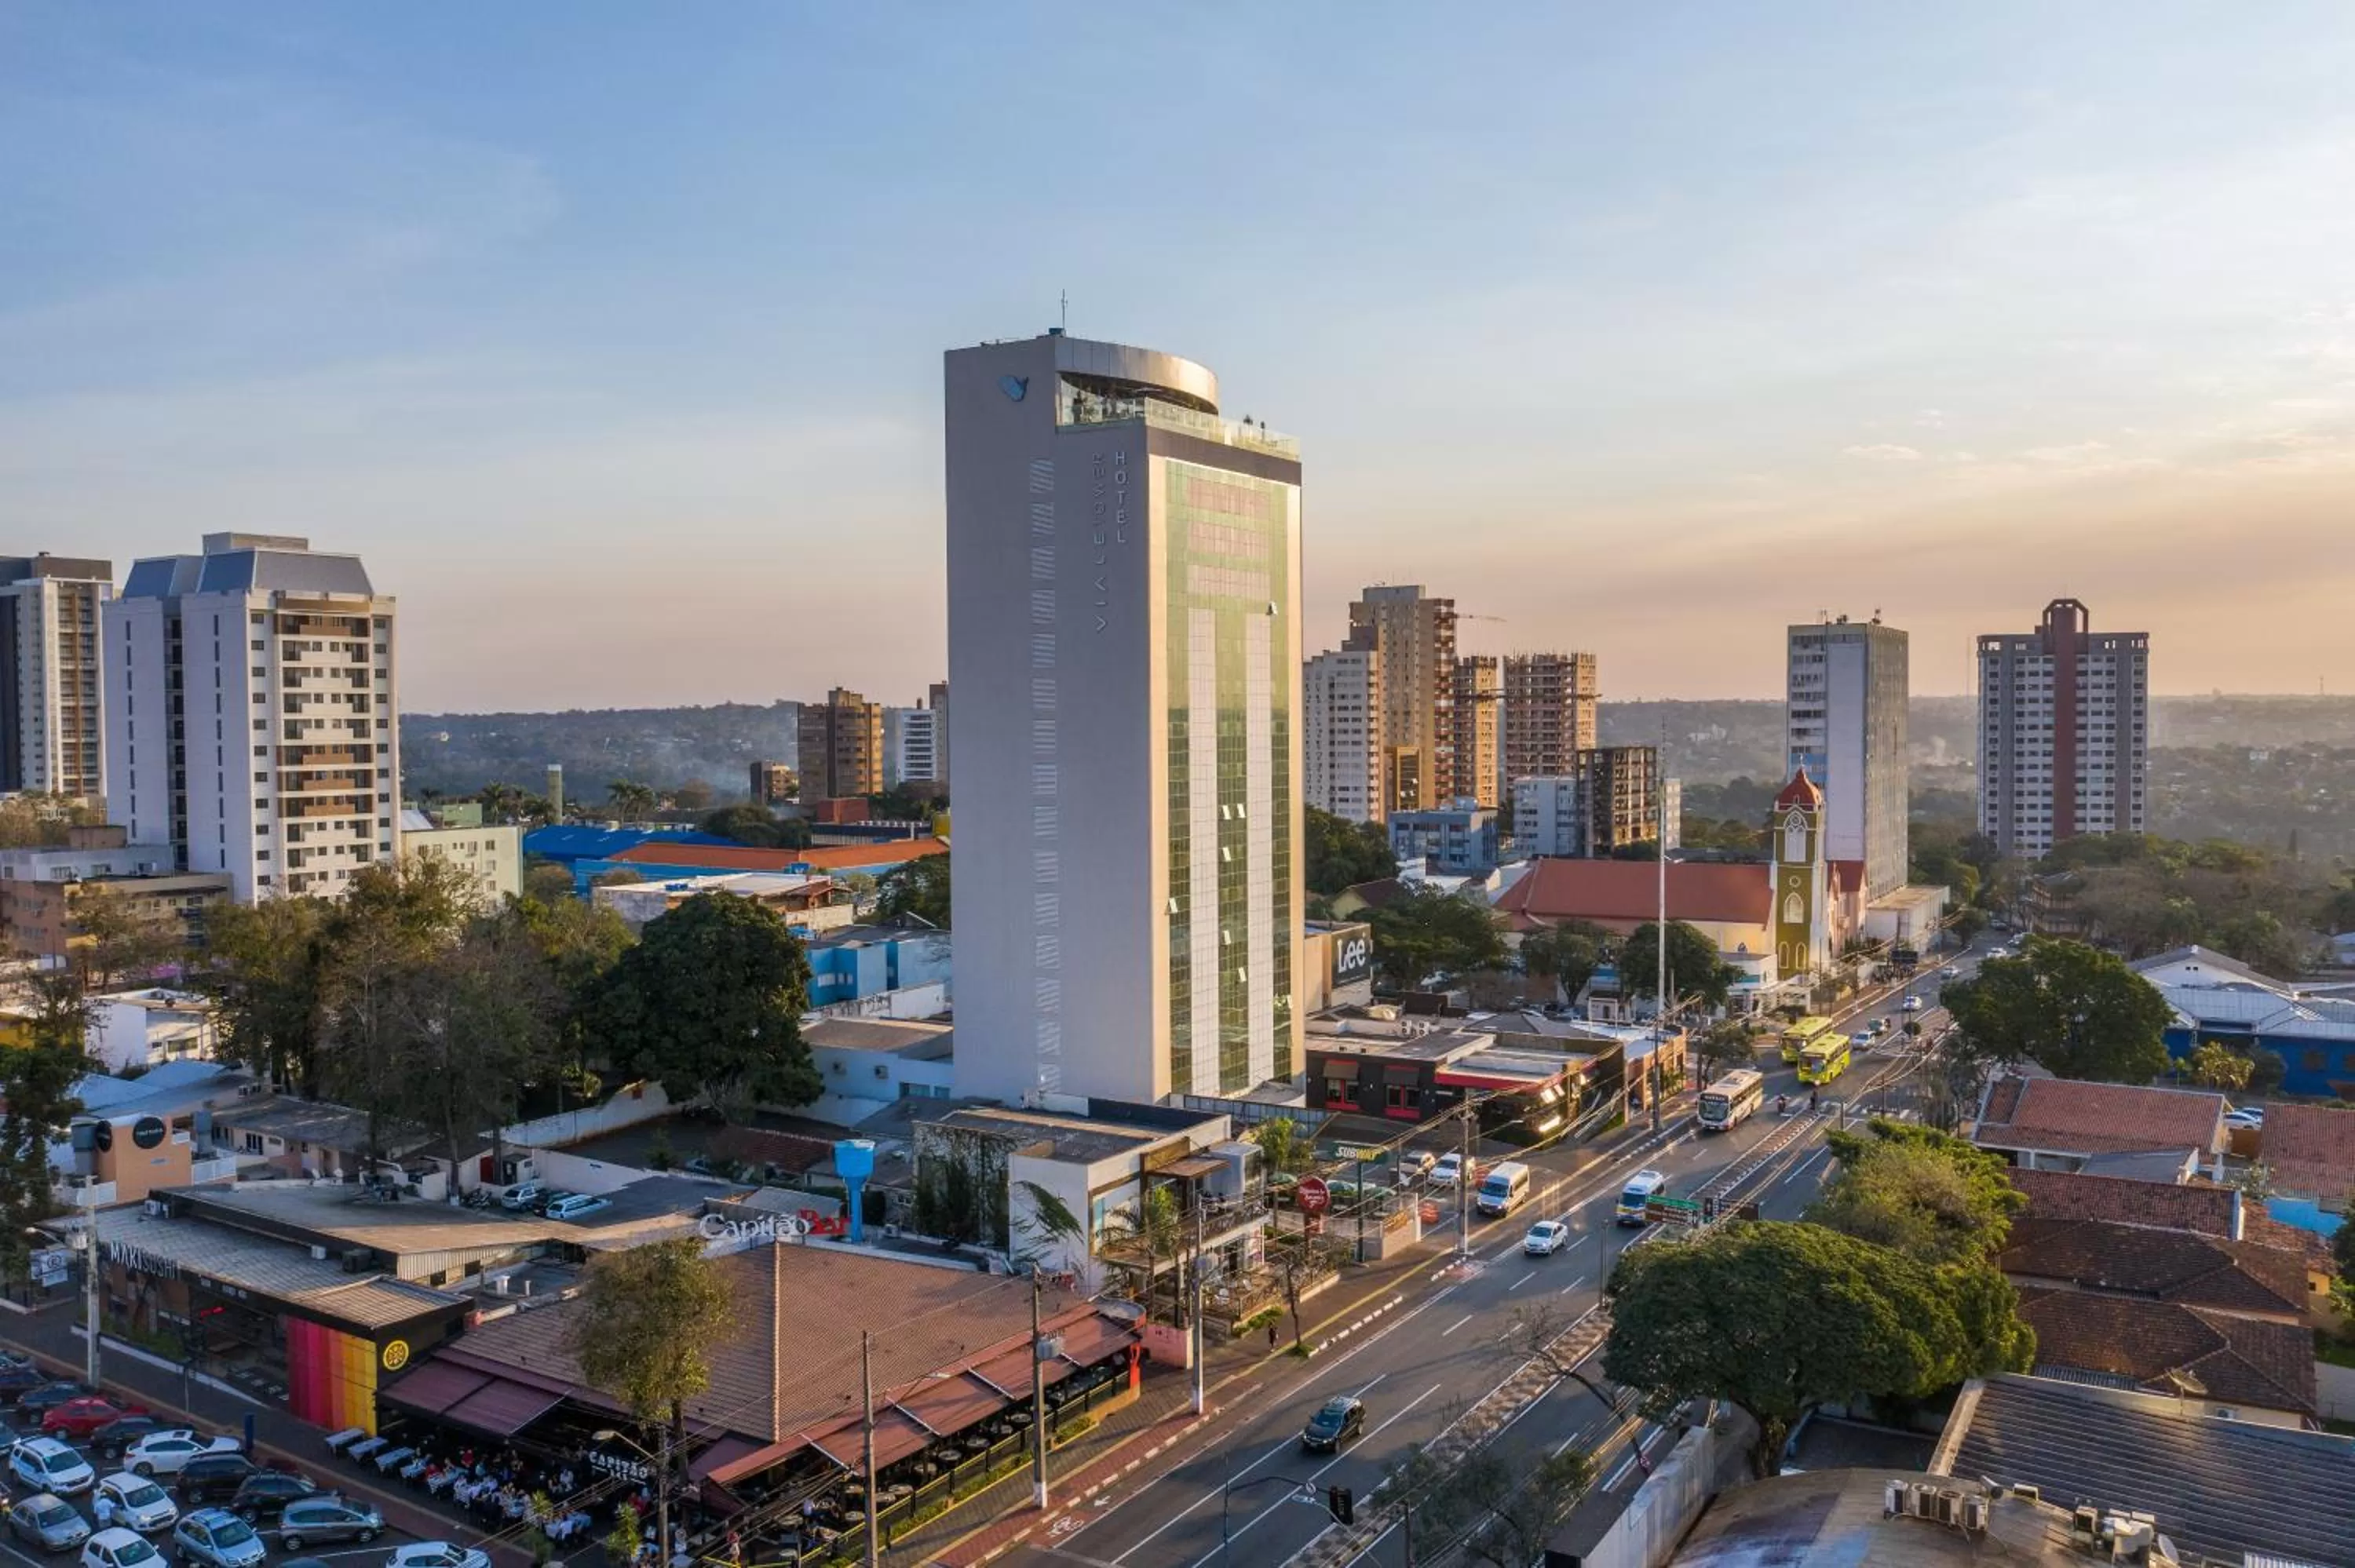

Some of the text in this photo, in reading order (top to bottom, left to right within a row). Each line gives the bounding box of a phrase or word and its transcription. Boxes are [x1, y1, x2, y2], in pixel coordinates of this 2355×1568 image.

[1115, 451, 1126, 543] HOTEL
[1092, 533, 1107, 633] VIALE
[1337, 939, 1366, 974] Lee
[699, 1212, 812, 1242] Capitão
